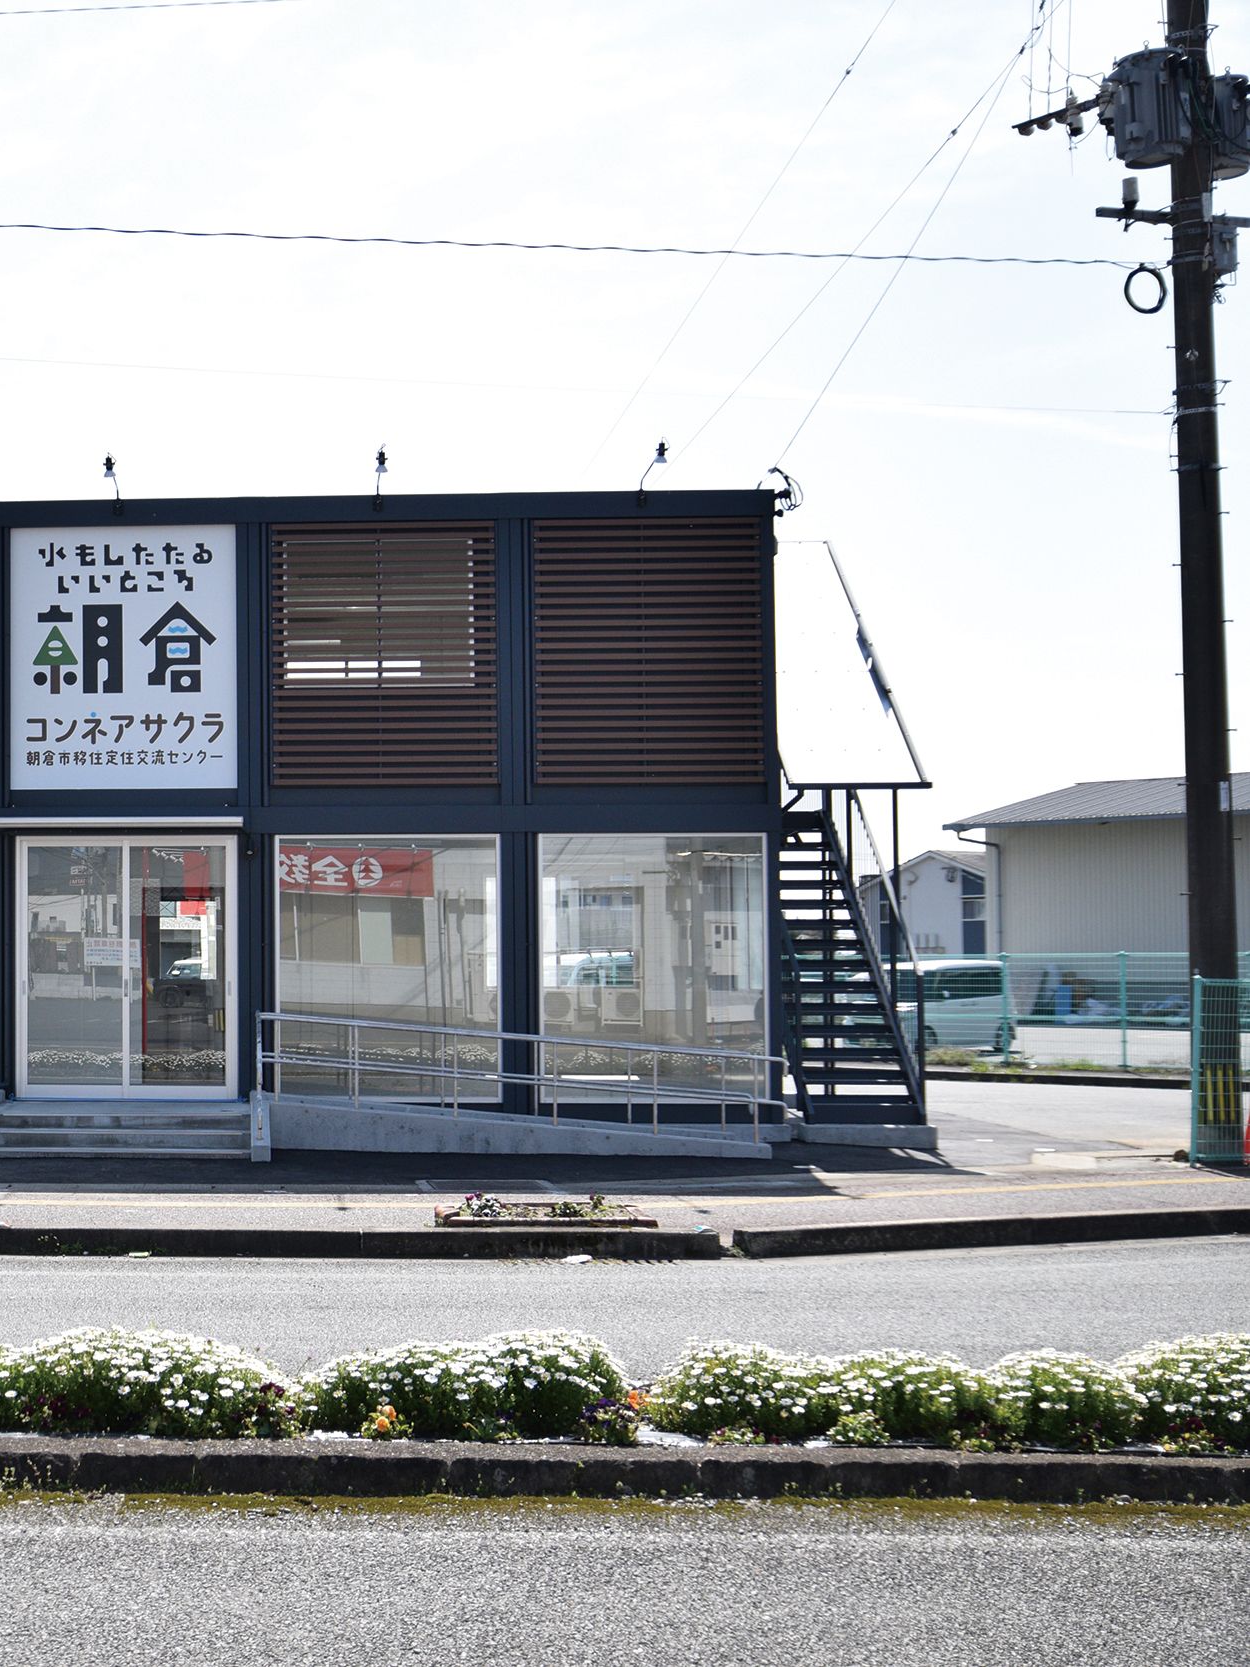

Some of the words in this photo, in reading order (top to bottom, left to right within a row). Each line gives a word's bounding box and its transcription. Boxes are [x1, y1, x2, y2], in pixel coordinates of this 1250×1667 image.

[38, 543, 212, 567] 水もしたたる
[58, 570, 194, 593] いいところ
[33, 601, 217, 694] 朝倉
[26, 712, 224, 744] コンネアサクラ
[26, 751, 223, 766] 朝倉市移住定住交流センター
